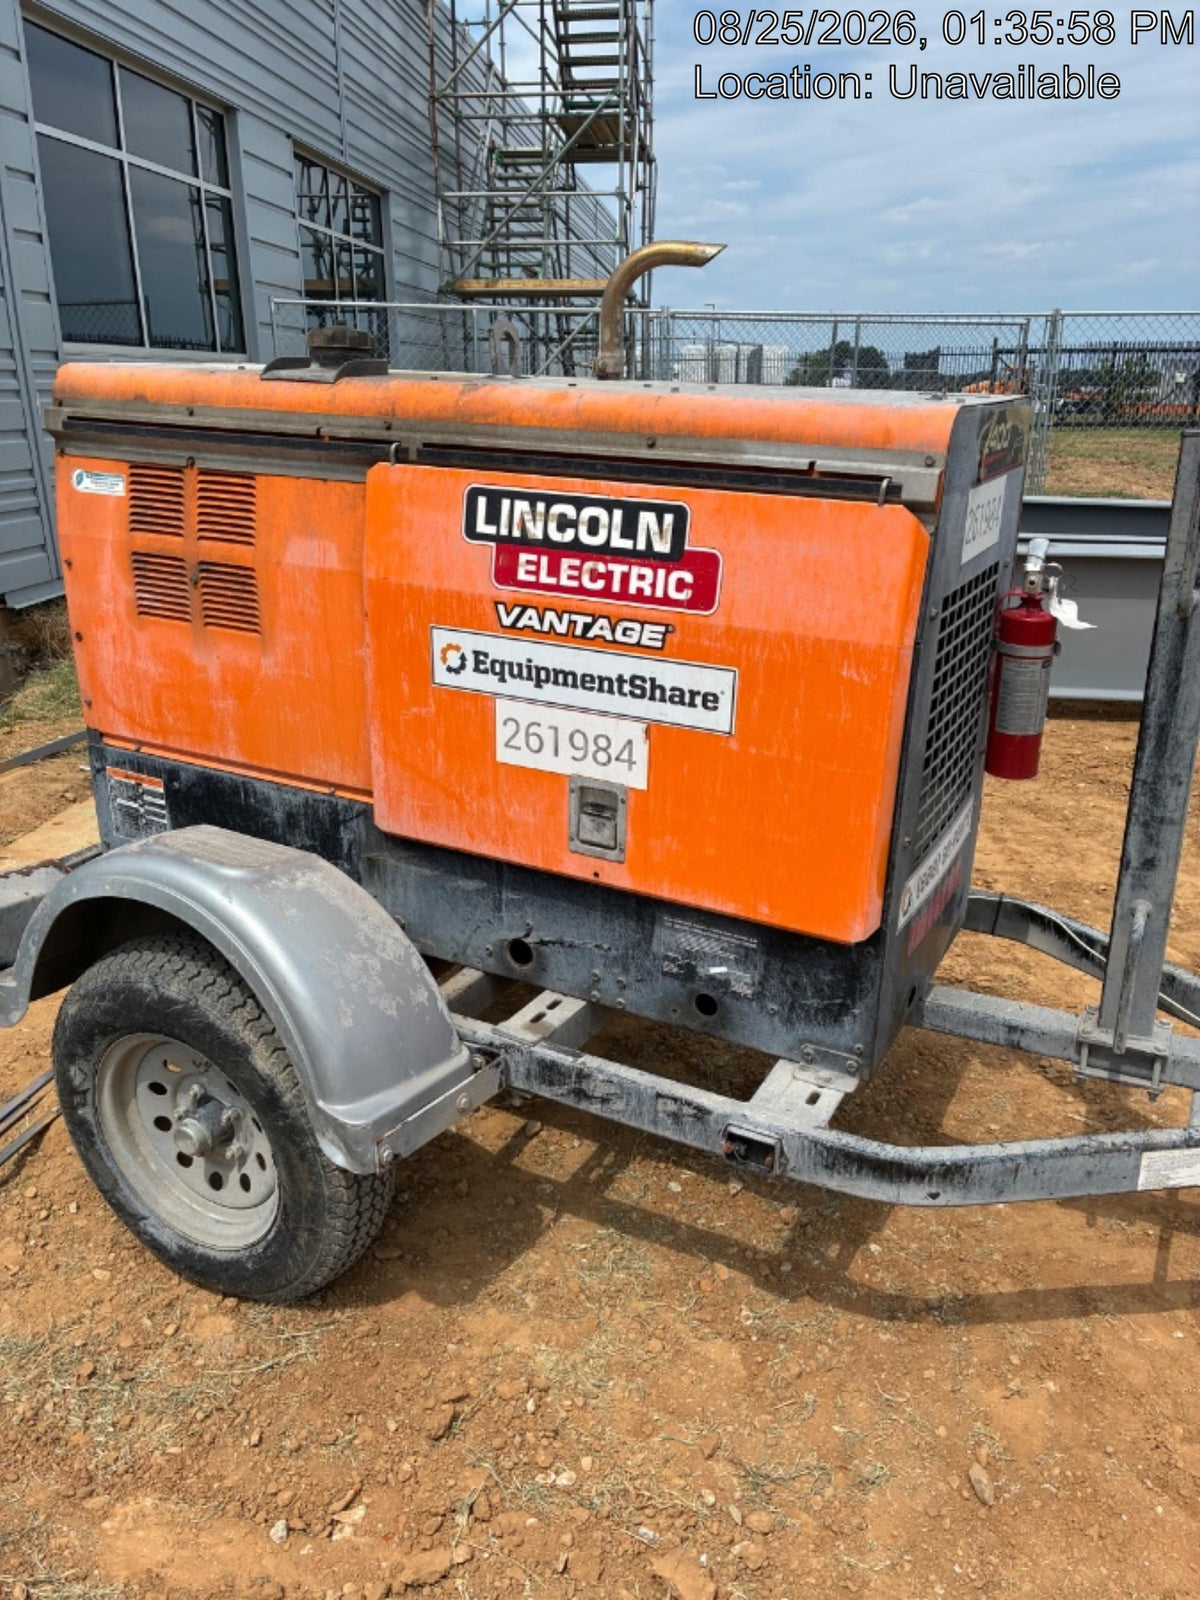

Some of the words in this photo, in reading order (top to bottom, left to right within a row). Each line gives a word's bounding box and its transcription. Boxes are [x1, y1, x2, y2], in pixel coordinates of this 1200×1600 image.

[475, 496, 675, 554] LINCOLN
[516, 552, 694, 601] ELECTRIC
[495, 601, 668, 650] VANTAGE
[472, 650, 720, 712] EquipmentShare
[502, 717, 637, 772] 261984
